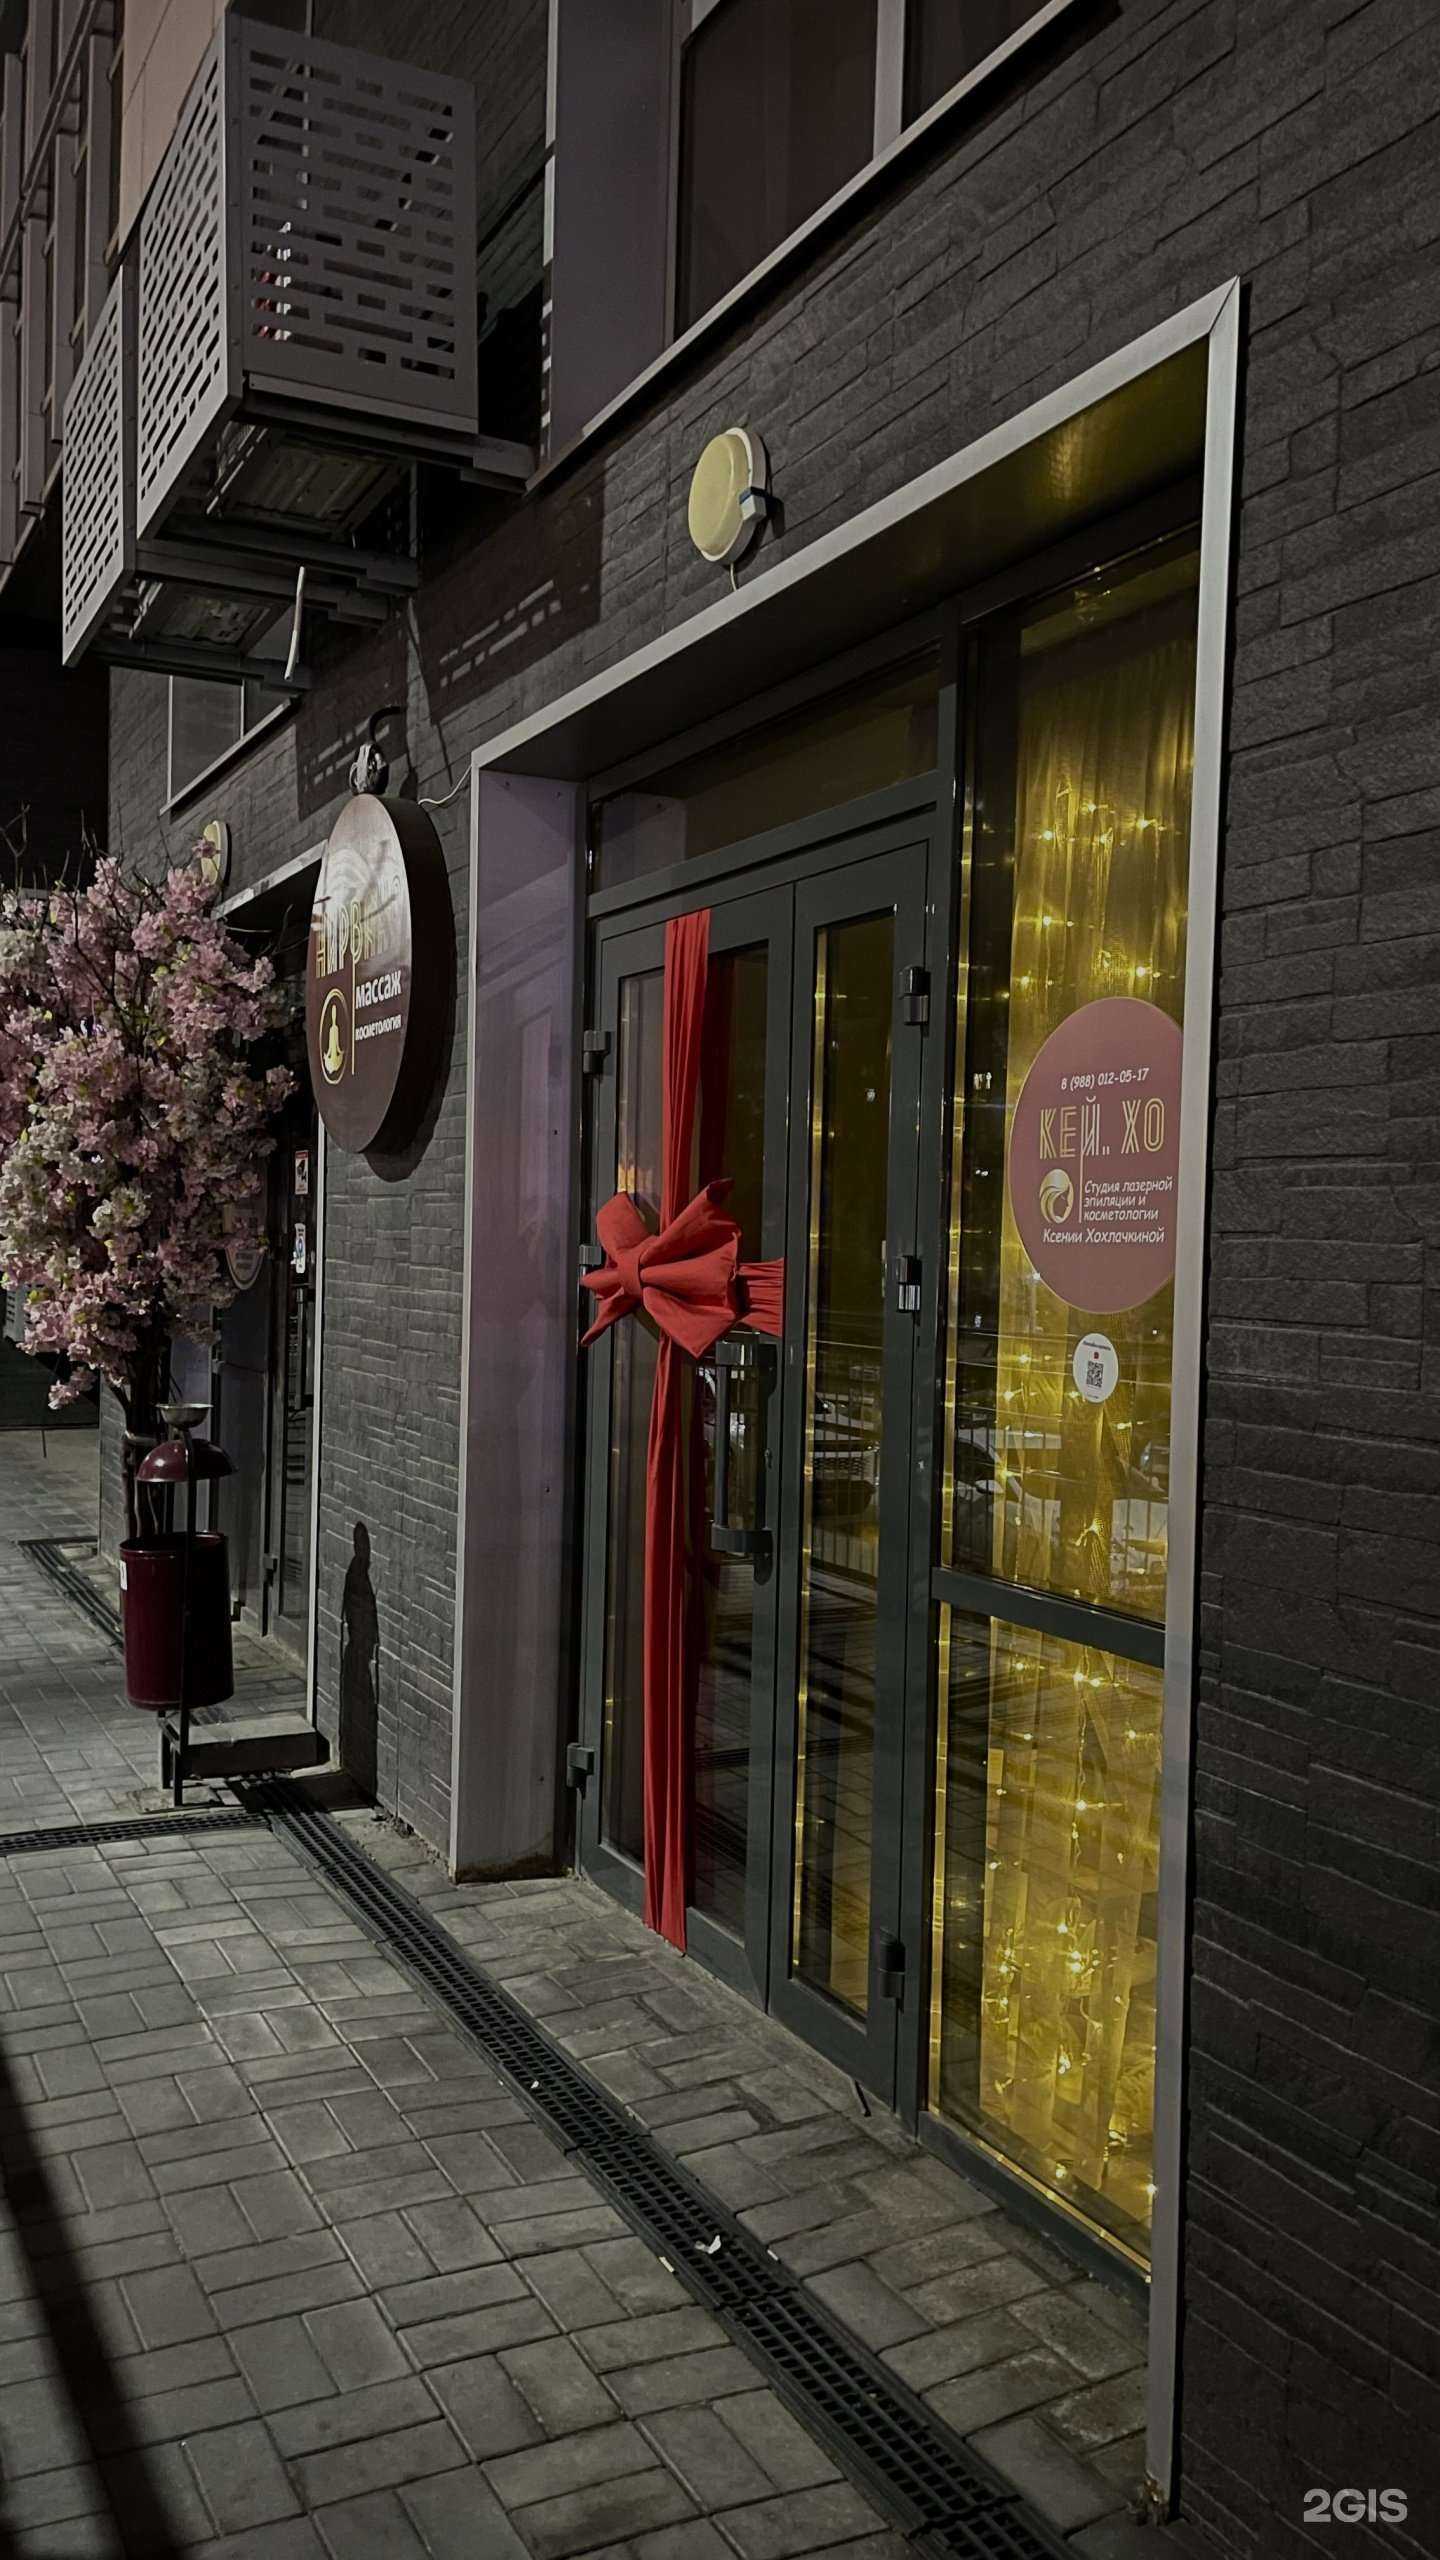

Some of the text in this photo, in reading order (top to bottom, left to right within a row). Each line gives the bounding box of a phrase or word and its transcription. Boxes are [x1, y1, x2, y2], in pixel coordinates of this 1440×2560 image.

[355, 970, 402, 1009] массаж
[355, 1014, 402, 1041] косметология
[1061, 1068, 1150, 1091] 8 (988) 012-05-17
[1121, 1098, 1165, 1154] ХО
[1084, 1176, 1173, 1196] Студия лазерной
[1083, 1196, 1147, 1208] эпиляции и
[1083, 1209, 1159, 1221] косметологии
[1043, 1227, 1165, 1243] Ксении Хохлачкиной
